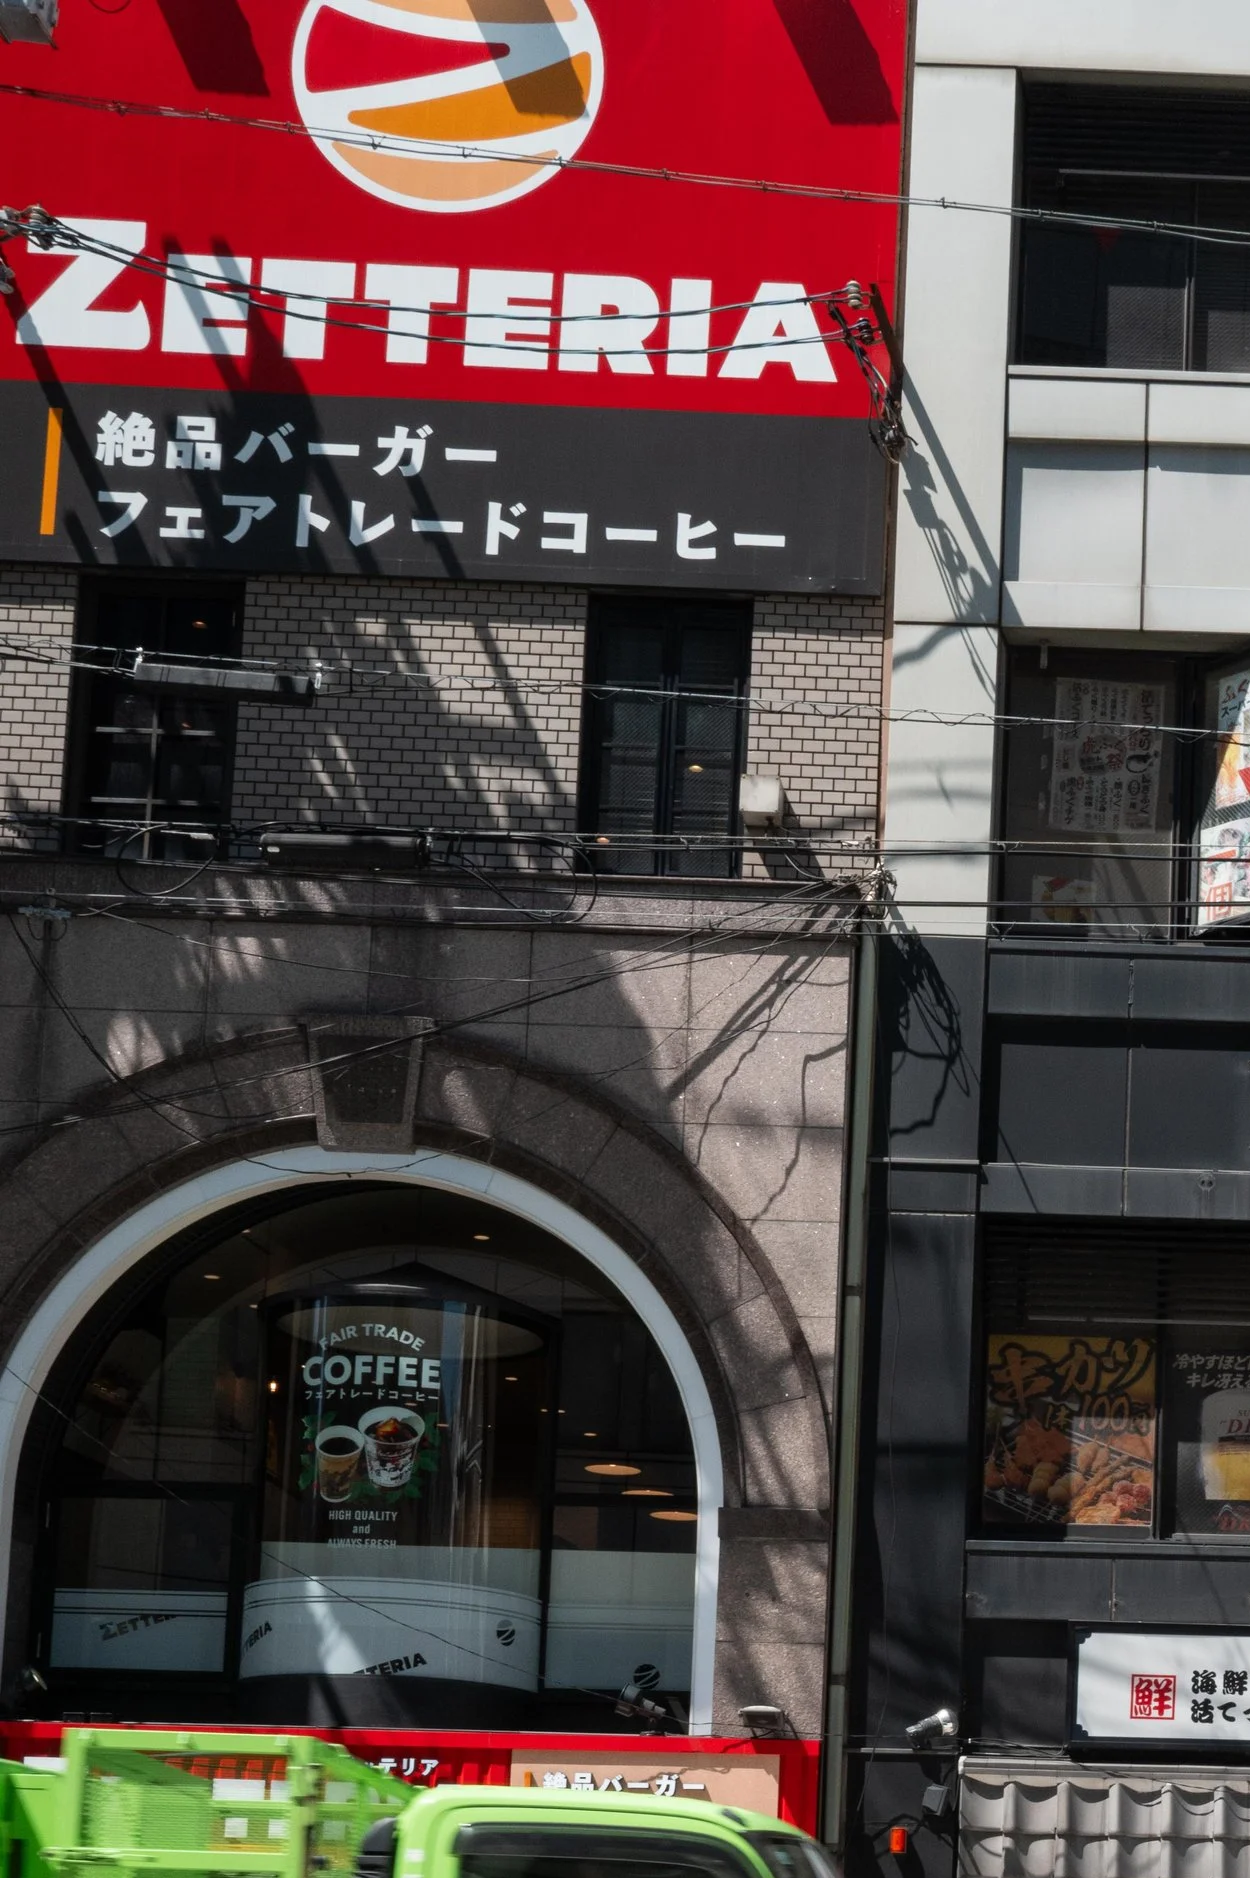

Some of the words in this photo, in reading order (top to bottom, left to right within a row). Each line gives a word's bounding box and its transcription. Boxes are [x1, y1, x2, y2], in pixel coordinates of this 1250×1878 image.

[15, 217, 837, 383] ZETTERIA
[96, 411, 498, 477] 絶品バーガー
[97, 490, 786, 561] フェアトレードコーヒー
[319, 1325, 358, 1350] FAIR
[362, 1324, 426, 1351] TRADE
[303, 1355, 441, 1389] COFFEE
[305, 1389, 439, 1401] フェアトレードコーヒー
[328, 1510, 351, 1520] HIGH
[354, 1510, 398, 1521] QUALITY
[352, 1524, 371, 1534] and
[327, 1538, 362, 1549] ALWAYS
[364, 1538, 397, 1549] FRESH
[1131, 1674, 1176, 1720] 鮮
[364, 1758, 439, 1776] テリア
